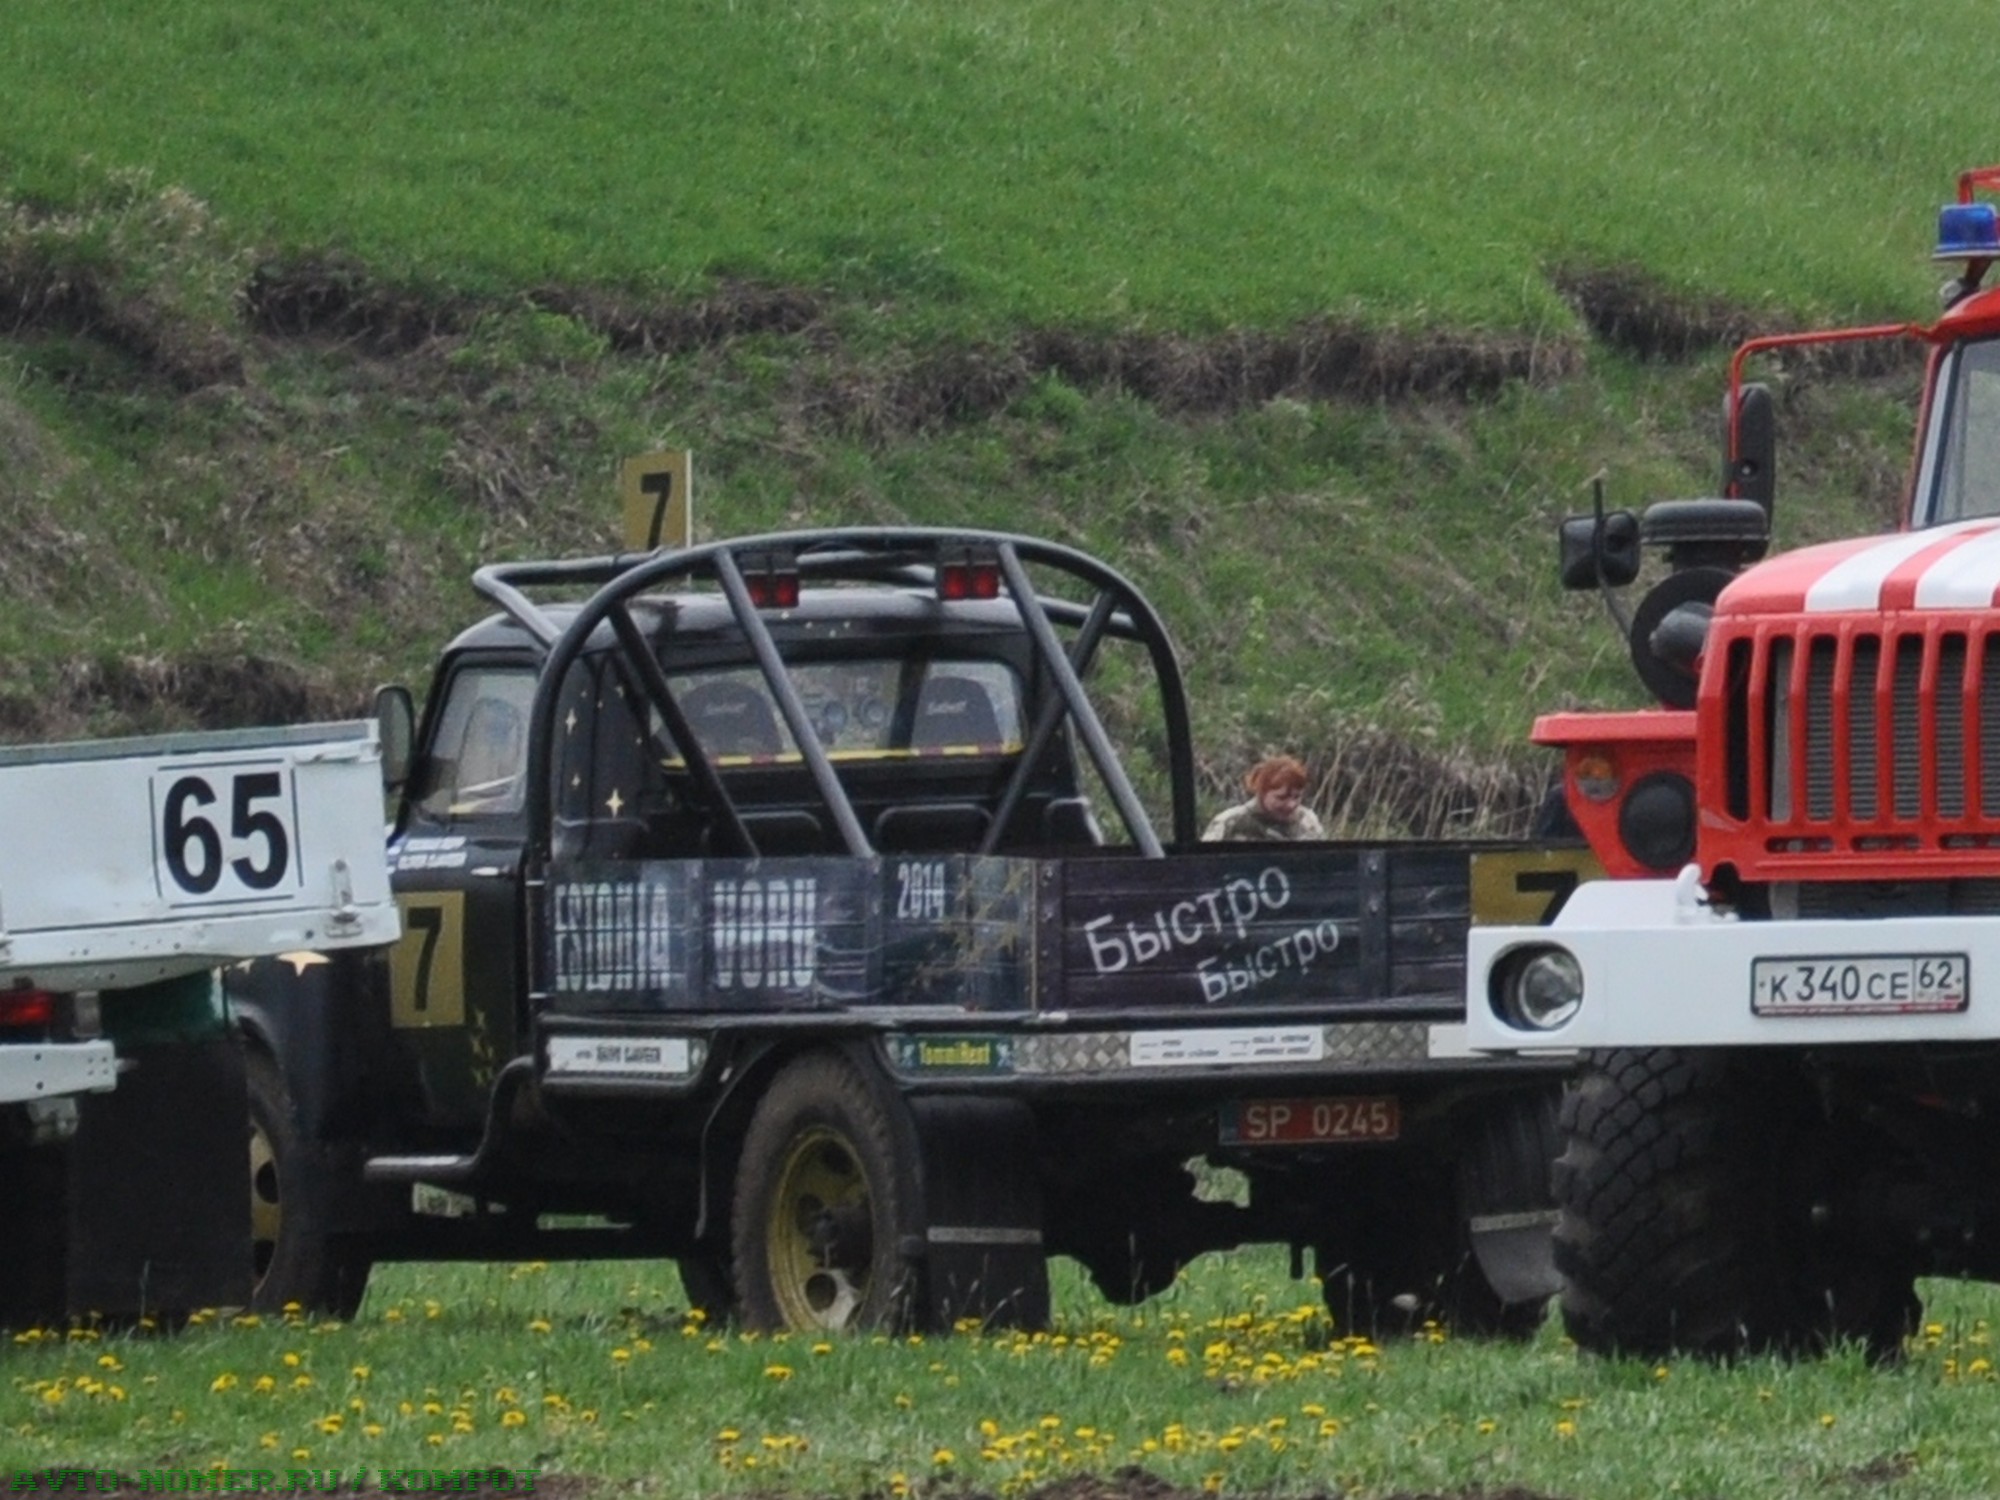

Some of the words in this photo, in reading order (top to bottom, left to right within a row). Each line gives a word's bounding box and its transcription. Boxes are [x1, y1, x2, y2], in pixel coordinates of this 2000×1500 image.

[640, 472, 672, 551] 7
[163, 771, 289, 894] 65
[407, 907, 443, 1011] 7
[1083, 866, 1291, 974] Быстро
[1197, 919, 1339, 1002] Быстро
[1918, 961, 1953, 989] 62
[1246, 1105, 1291, 1138] SP
[1312, 1102, 1389, 1136] 0245
